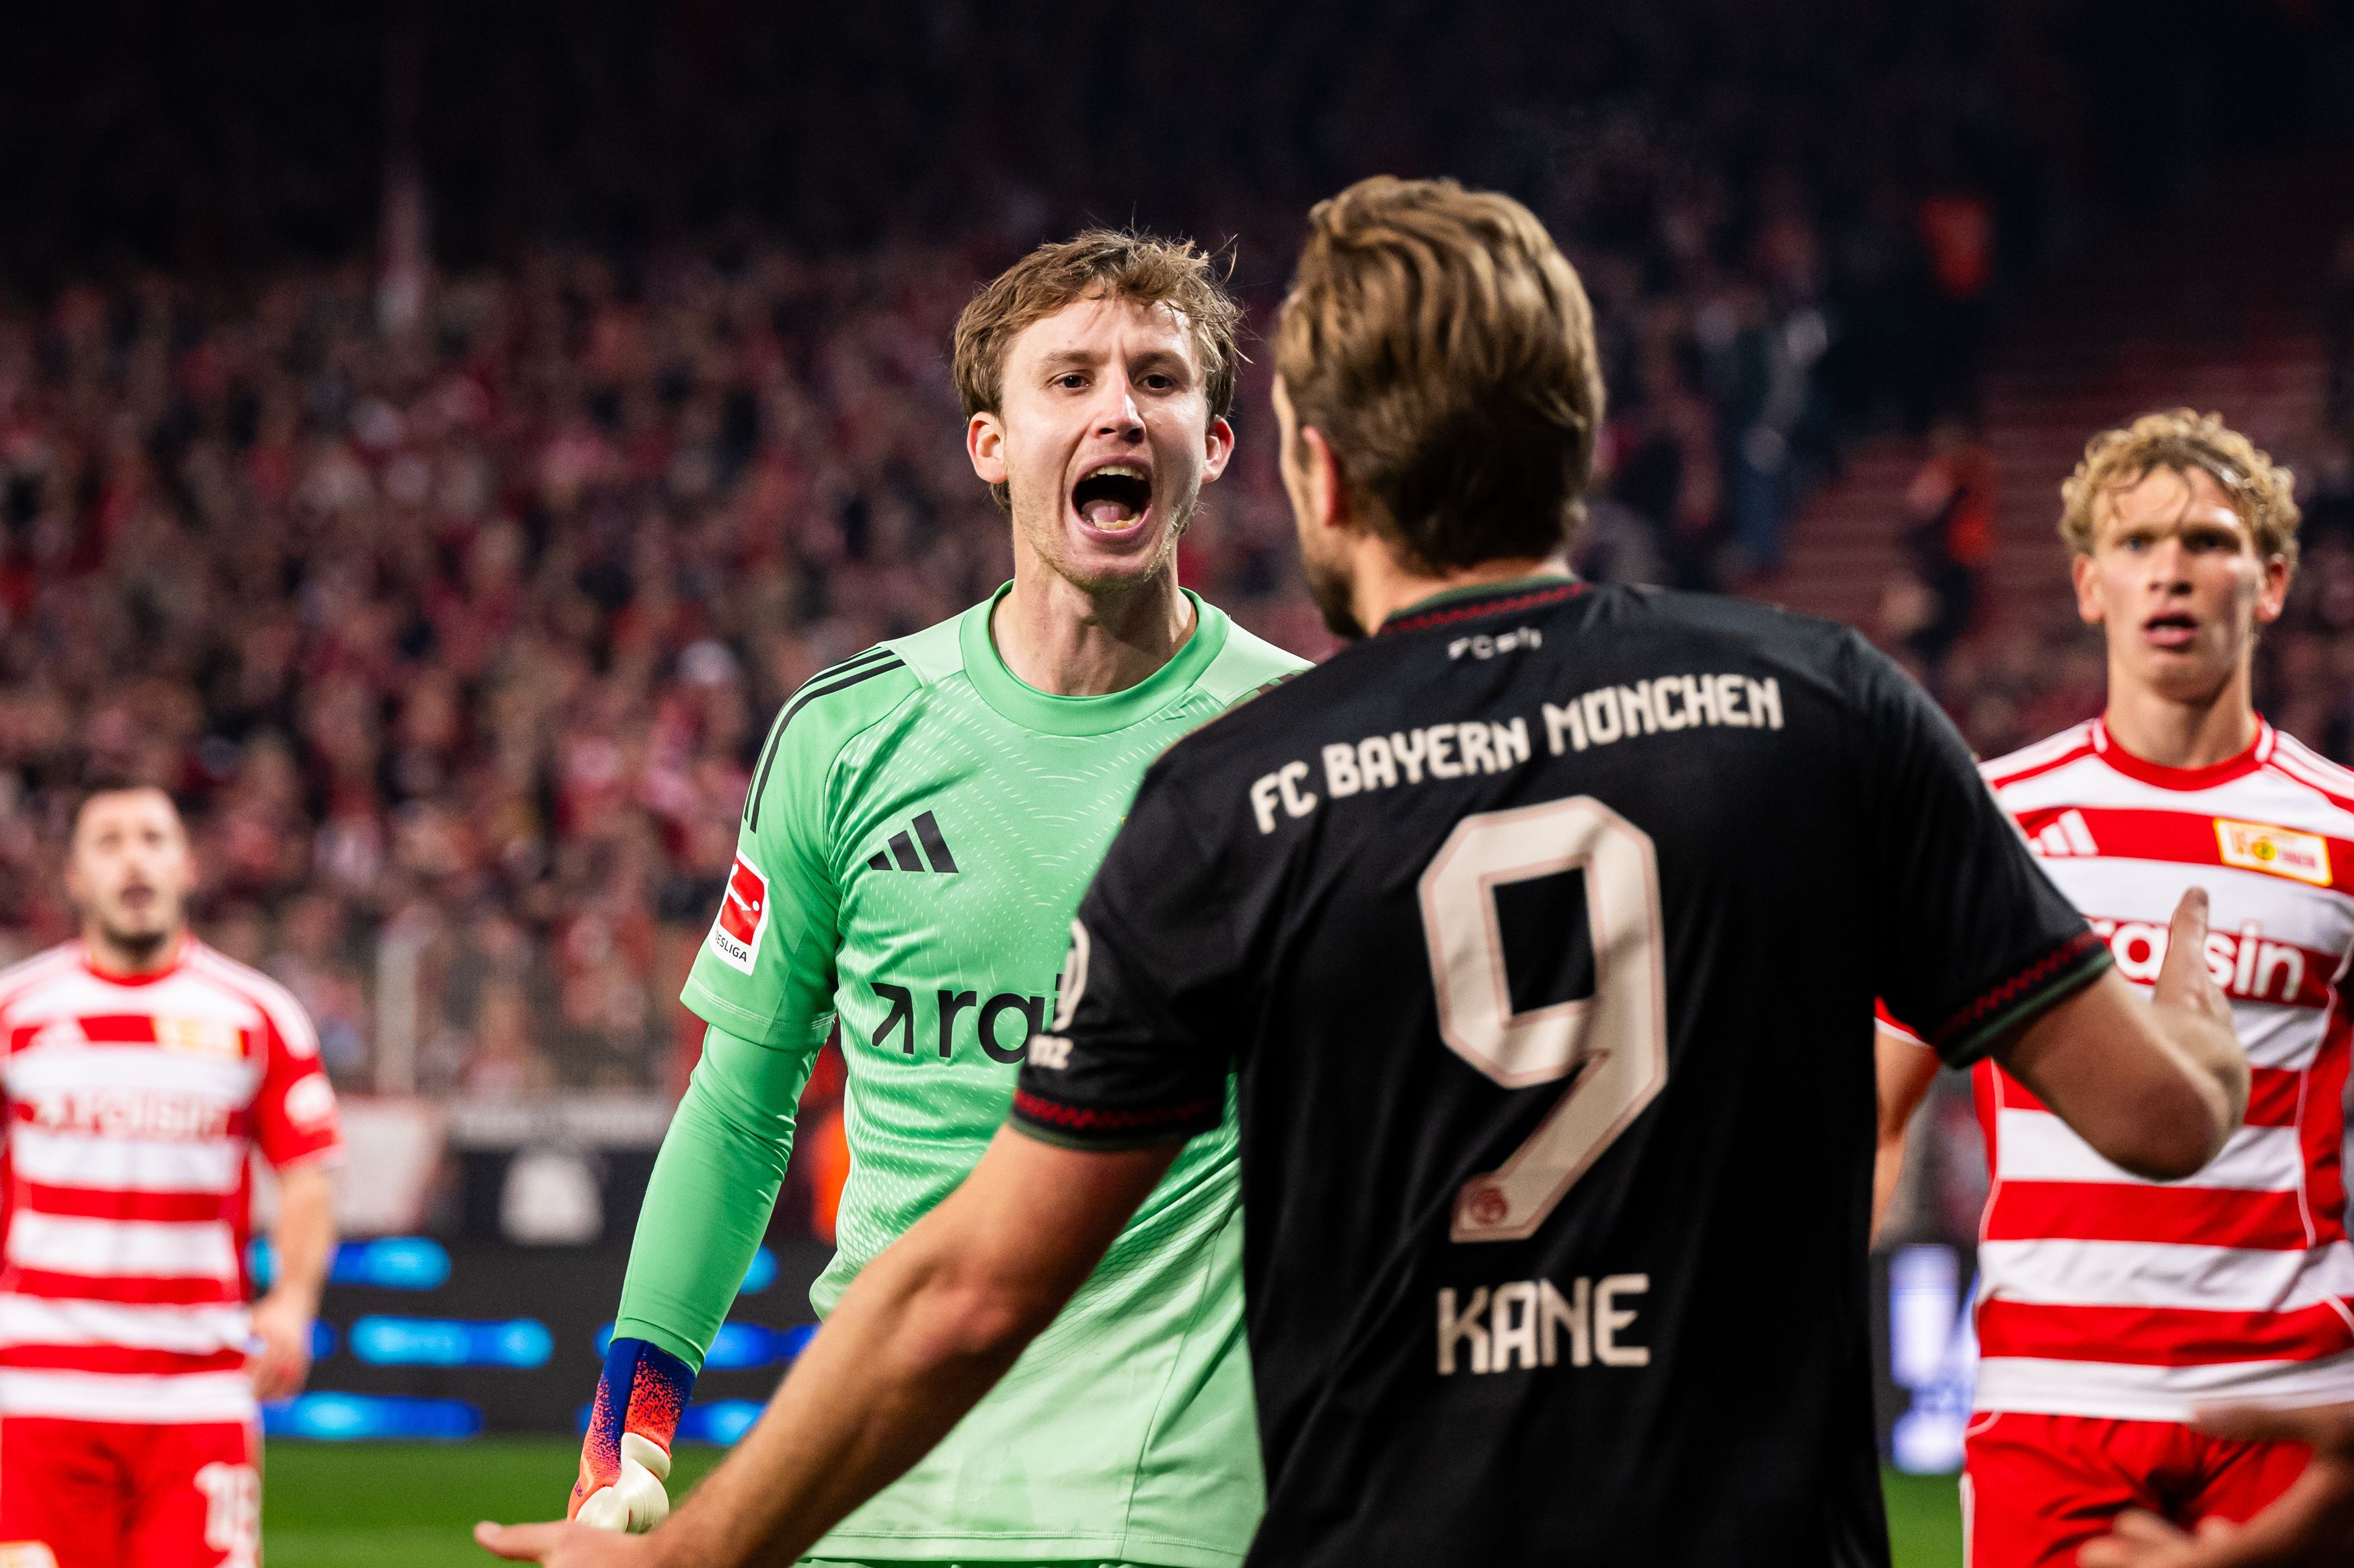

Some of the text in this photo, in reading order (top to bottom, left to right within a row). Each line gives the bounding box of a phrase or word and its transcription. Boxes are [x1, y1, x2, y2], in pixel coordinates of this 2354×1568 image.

[1251, 760, 1317, 834] FC
[1322, 718, 1531, 799] BAYERN
[2087, 921, 2305, 1001] asin
[1417, 794, 1668, 1243] 9
[1437, 1273, 1650, 1375] KANE
